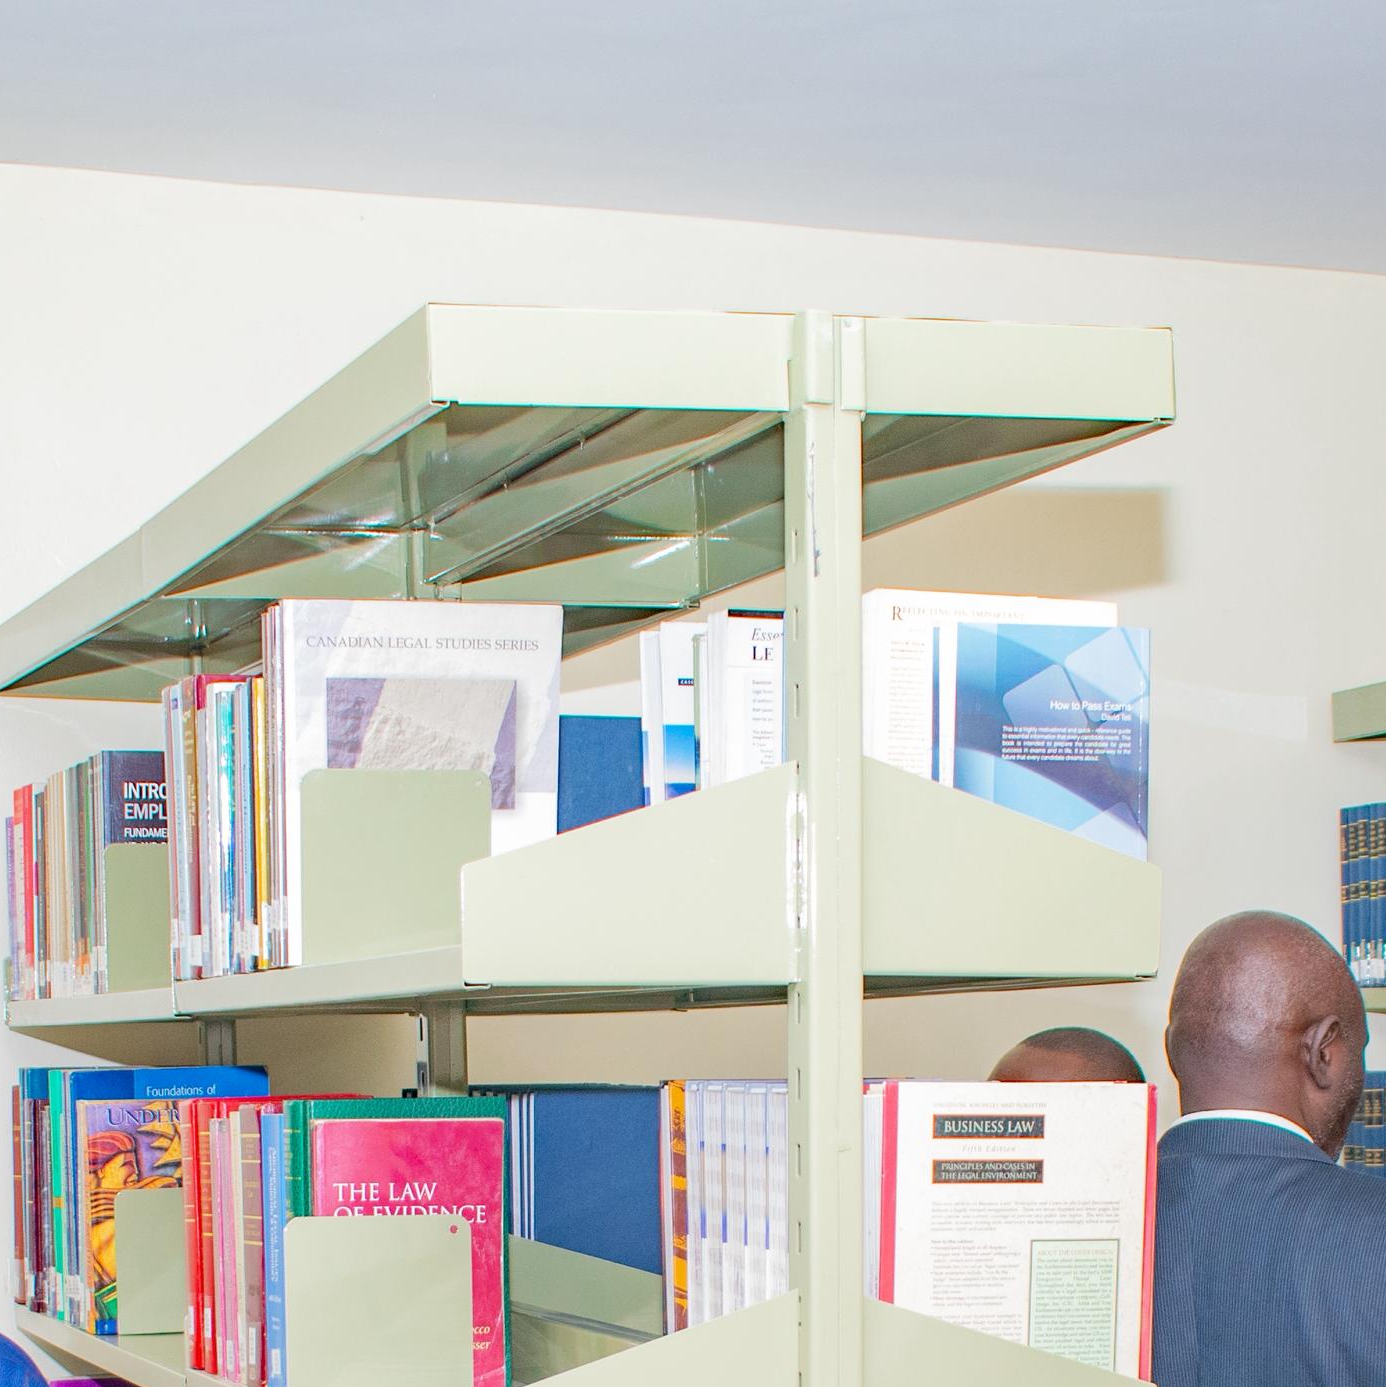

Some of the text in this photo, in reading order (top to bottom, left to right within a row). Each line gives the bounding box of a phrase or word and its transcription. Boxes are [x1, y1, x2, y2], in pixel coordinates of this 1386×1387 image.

[306, 636, 539, 651] CANADIAN LEGAL STUDIES SERIES
[752, 646, 774, 661] LE
[1050, 700, 1132, 711] How to Pass Exams
[1101, 713, 1119, 721] David
[123, 782, 167, 799] INTRO
[124, 802, 167, 820] EMPL
[124, 827, 167, 838] FUNDAME
[146, 1084, 216, 1097] Foundations of
[106, 1107, 180, 1127] UNDER
[944, 1120, 1035, 1133] BUSINESS LAW
[942, 1162, 1035, 1171] PRINCIPLES AND CASES IN
[942, 1171, 1038, 1180] THE LEGAL ENVIRONMENT
[333, 1181, 437, 1202] THE LAW
[373, 1204, 487, 1224] EVIDENCE
